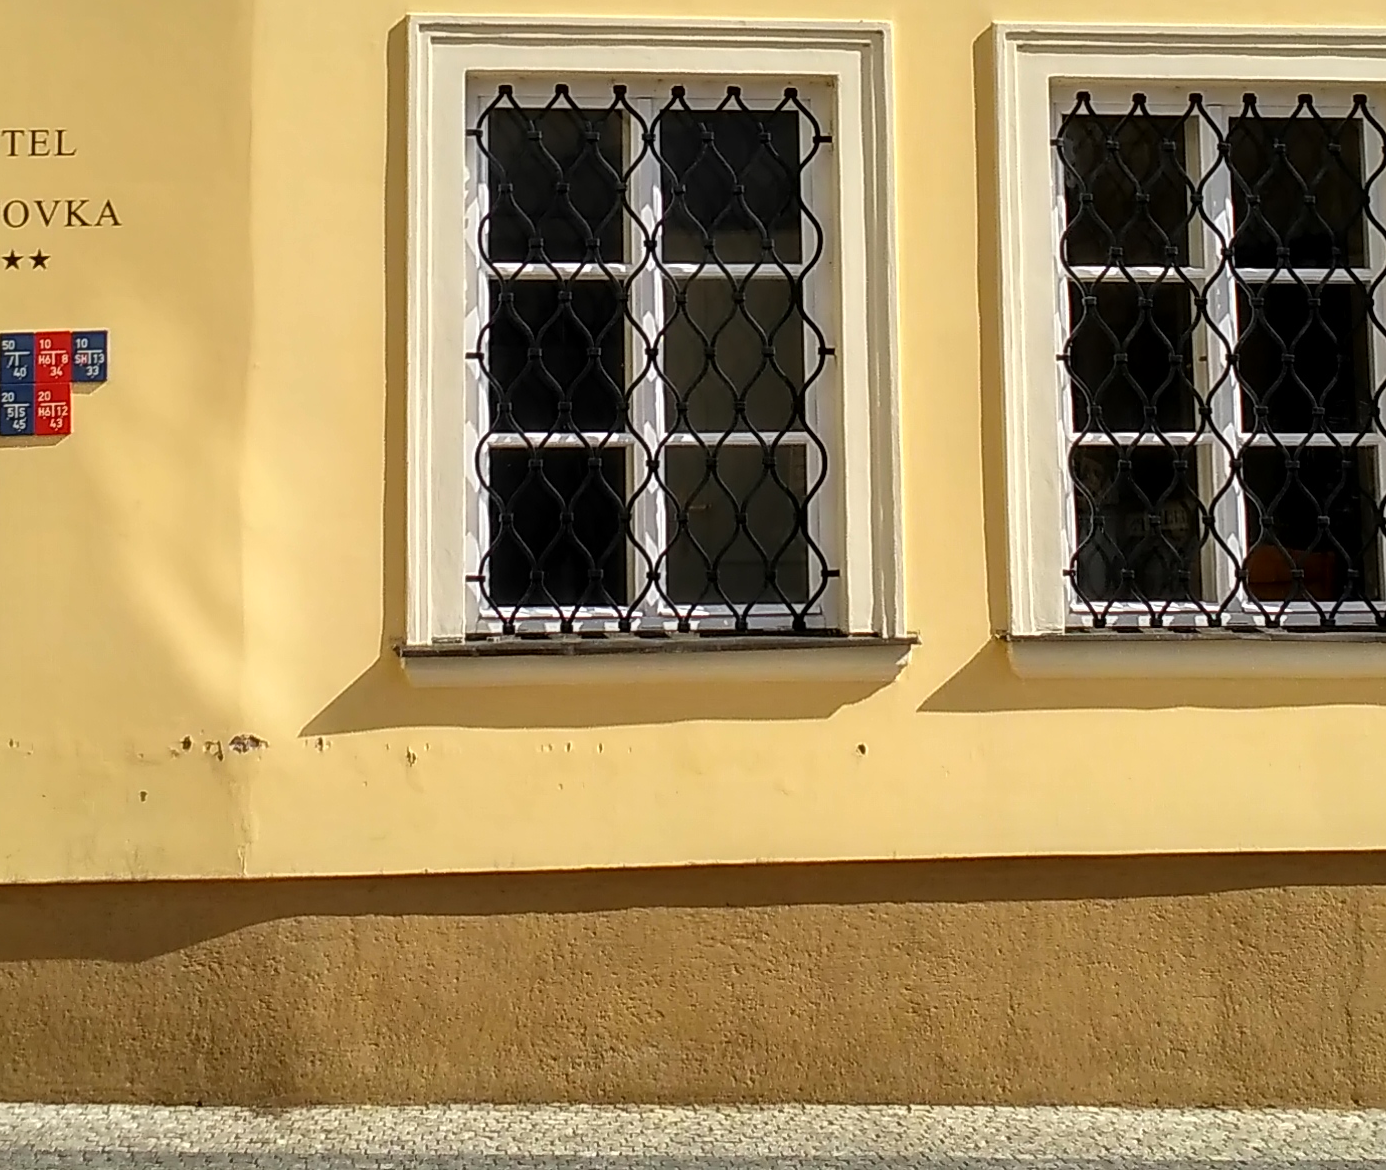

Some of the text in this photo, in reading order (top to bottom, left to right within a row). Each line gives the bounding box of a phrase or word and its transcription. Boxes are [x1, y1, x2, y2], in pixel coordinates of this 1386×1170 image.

[1, 340, 16, 350] 50
[39, 339, 52, 349] 10
[75, 338, 88, 349] 10
[1, 392, 15, 402] 20
[37, 391, 51, 401] 20
